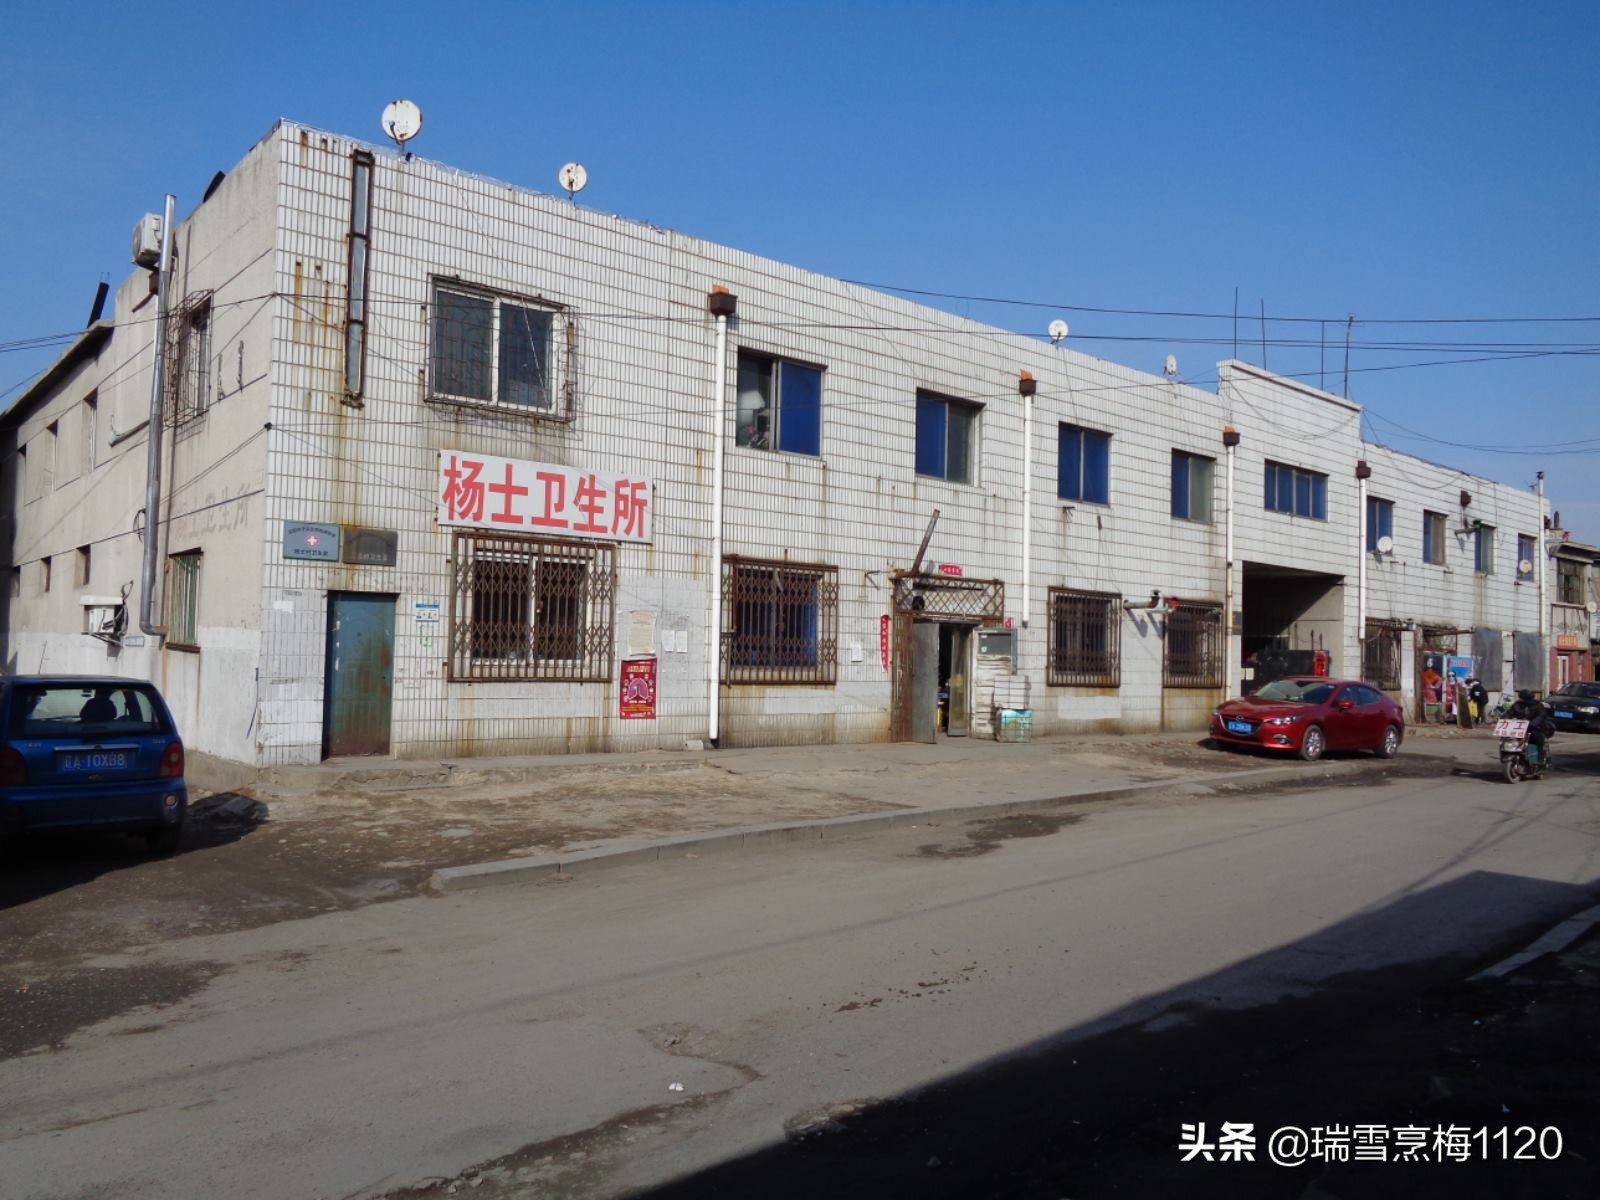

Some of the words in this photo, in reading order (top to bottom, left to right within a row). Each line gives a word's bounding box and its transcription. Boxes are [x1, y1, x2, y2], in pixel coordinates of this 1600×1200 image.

[442, 455, 648, 538] 杨士卫生所
